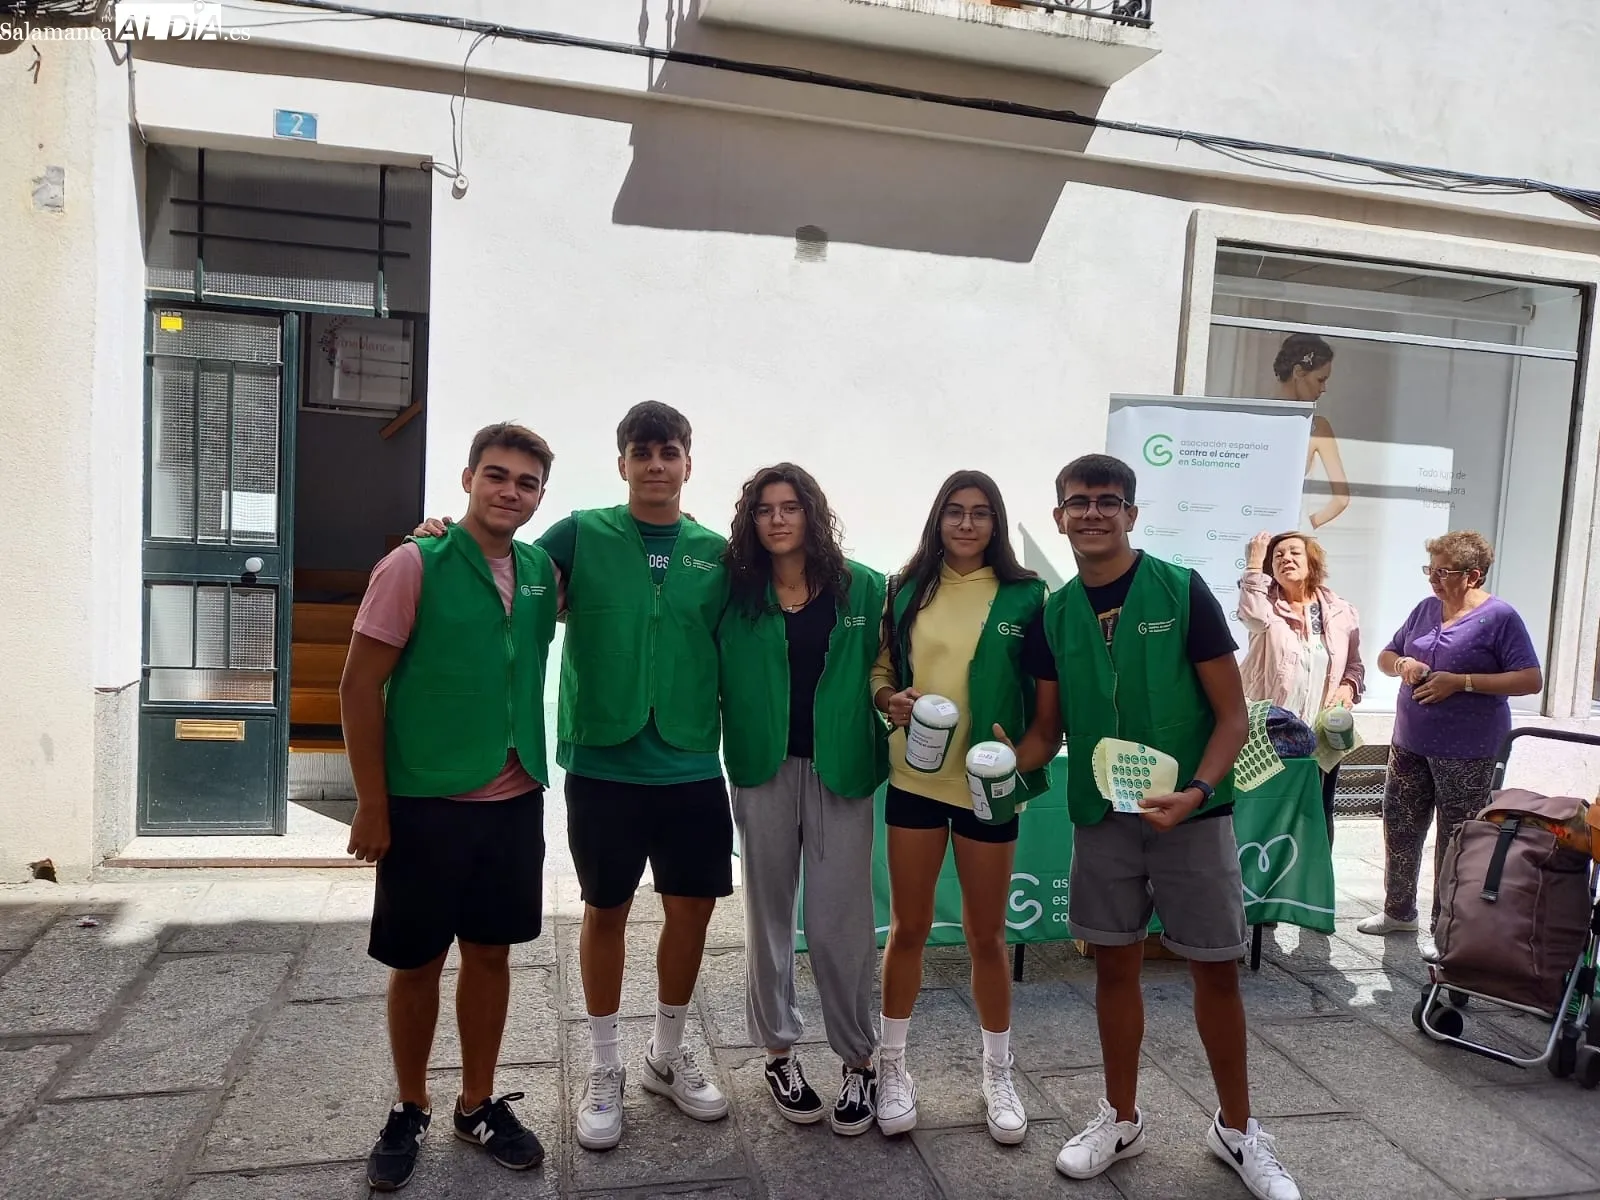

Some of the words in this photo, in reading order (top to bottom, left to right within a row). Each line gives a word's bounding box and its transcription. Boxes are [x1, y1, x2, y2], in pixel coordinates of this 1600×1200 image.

[289, 113, 304, 136] 2
[1180, 439, 1227, 449] asociación
[1228, 441, 1269, 451] española
[1179, 448, 1208, 457] contra
[1209, 449, 1218, 457] el
[1219, 449, 1249, 460] cáncer
[1178, 458, 1189, 466] en
[1191, 457, 1241, 469] Salamanca
